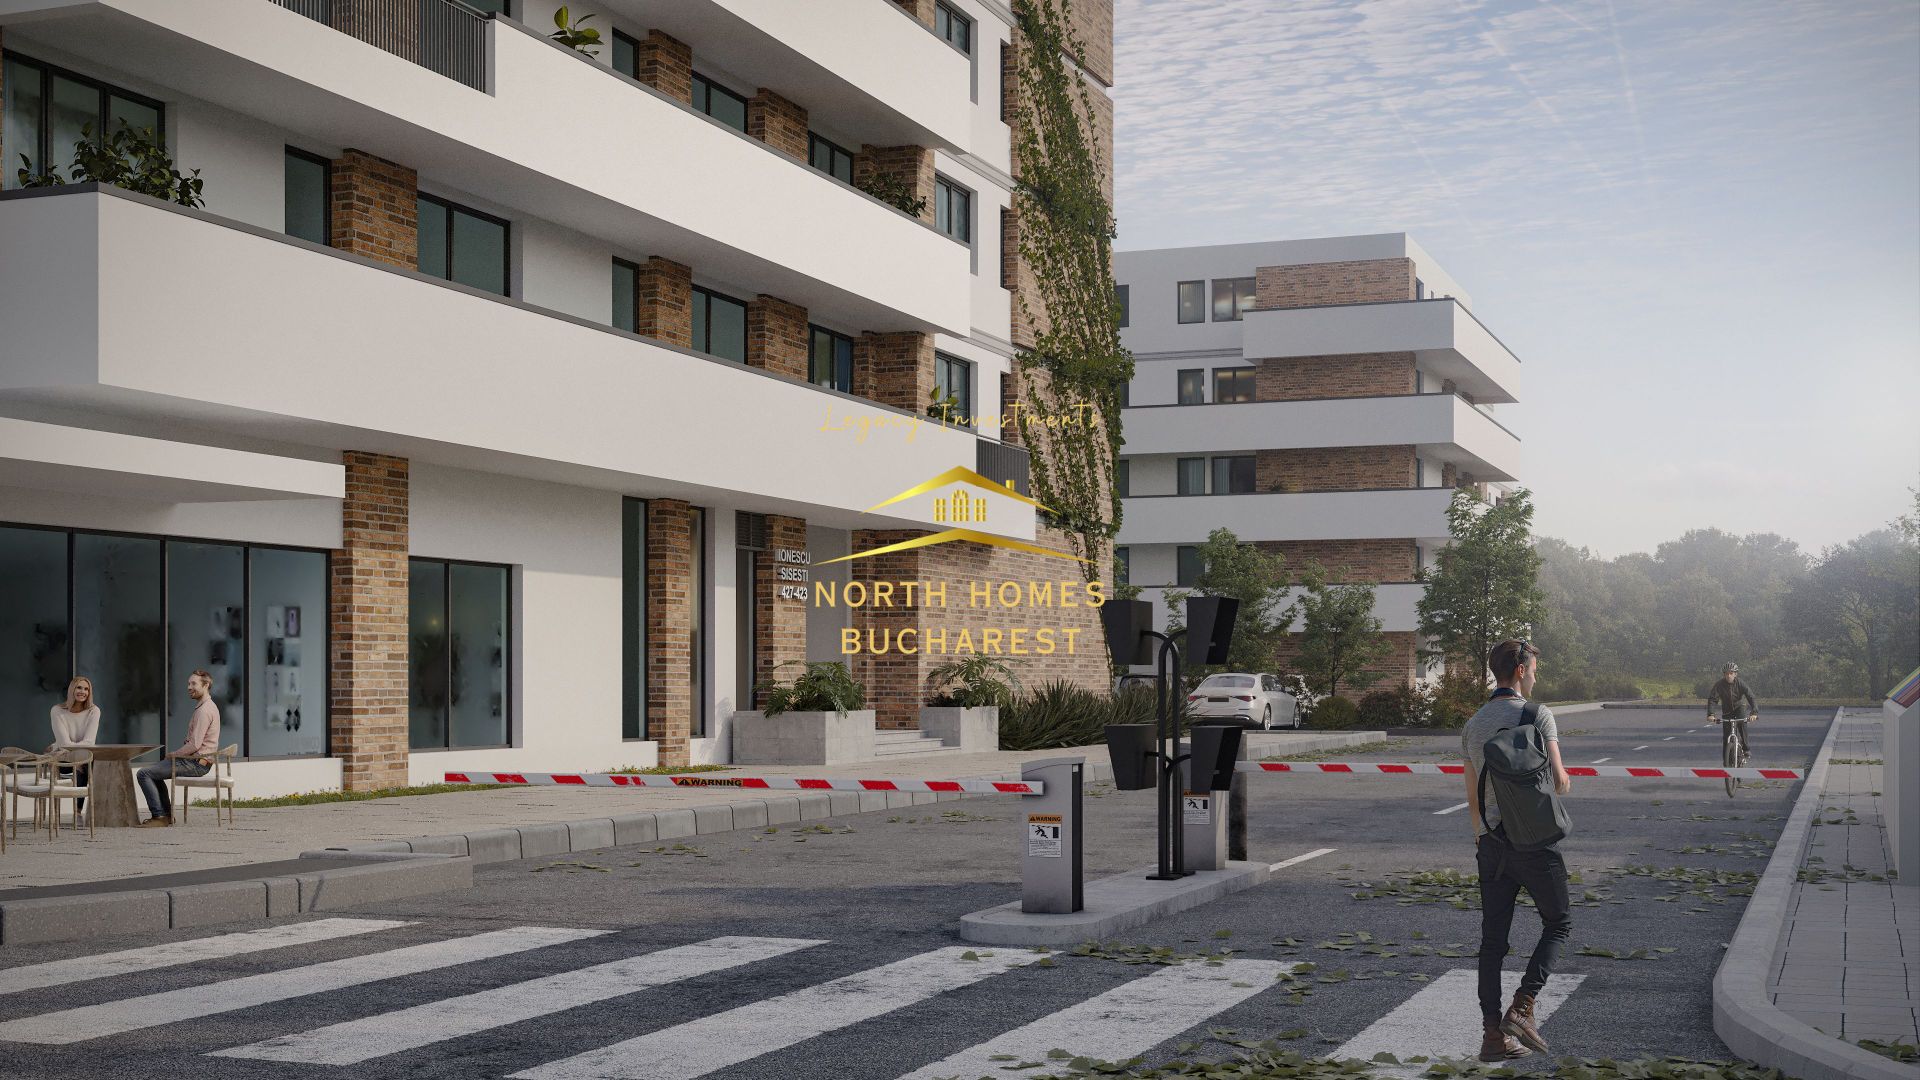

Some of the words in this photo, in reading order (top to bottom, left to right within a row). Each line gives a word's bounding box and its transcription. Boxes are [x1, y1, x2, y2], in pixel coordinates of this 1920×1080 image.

[778, 549, 811, 565] IONESCU
[781, 567, 809, 582] SISESTI
[691, 779, 742, 787] WARNING
